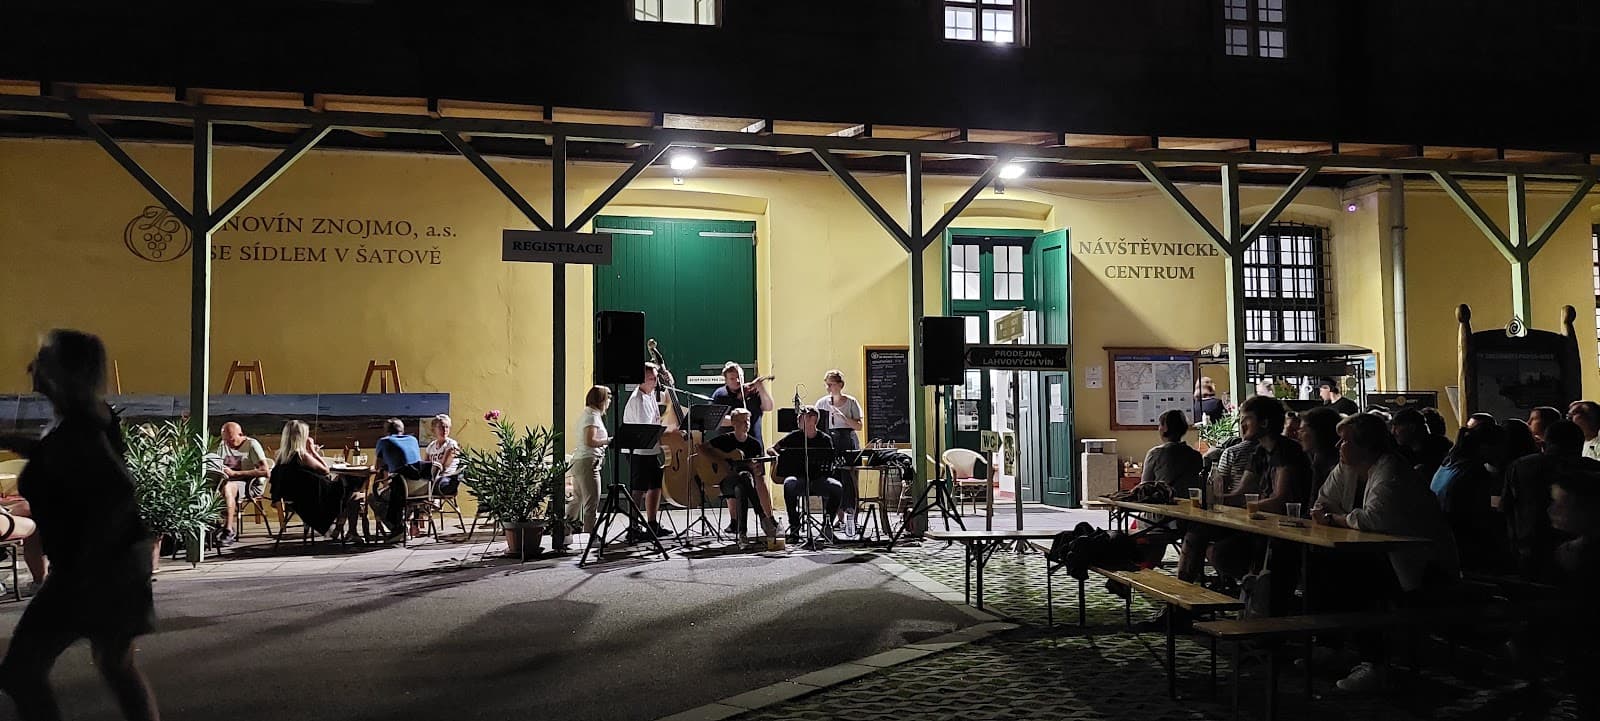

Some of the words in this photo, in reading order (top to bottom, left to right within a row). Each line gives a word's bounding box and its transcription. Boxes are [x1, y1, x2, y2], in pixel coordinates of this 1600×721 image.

[221, 212, 304, 233] NOVÍN
[311, 218, 418, 239] ZNOJMO,
[426, 225, 457, 237] a.s.
[239, 241, 327, 262] SÍDLEM
[334, 247, 350, 263] V
[355, 244, 442, 265] ŠATOVĚ
[512, 241, 604, 254] REGISTRACE
[1104, 265, 1196, 280] CENTRUM
[994, 350, 1042, 358] PRODEJNA
[983, 435, 995, 448] WC
